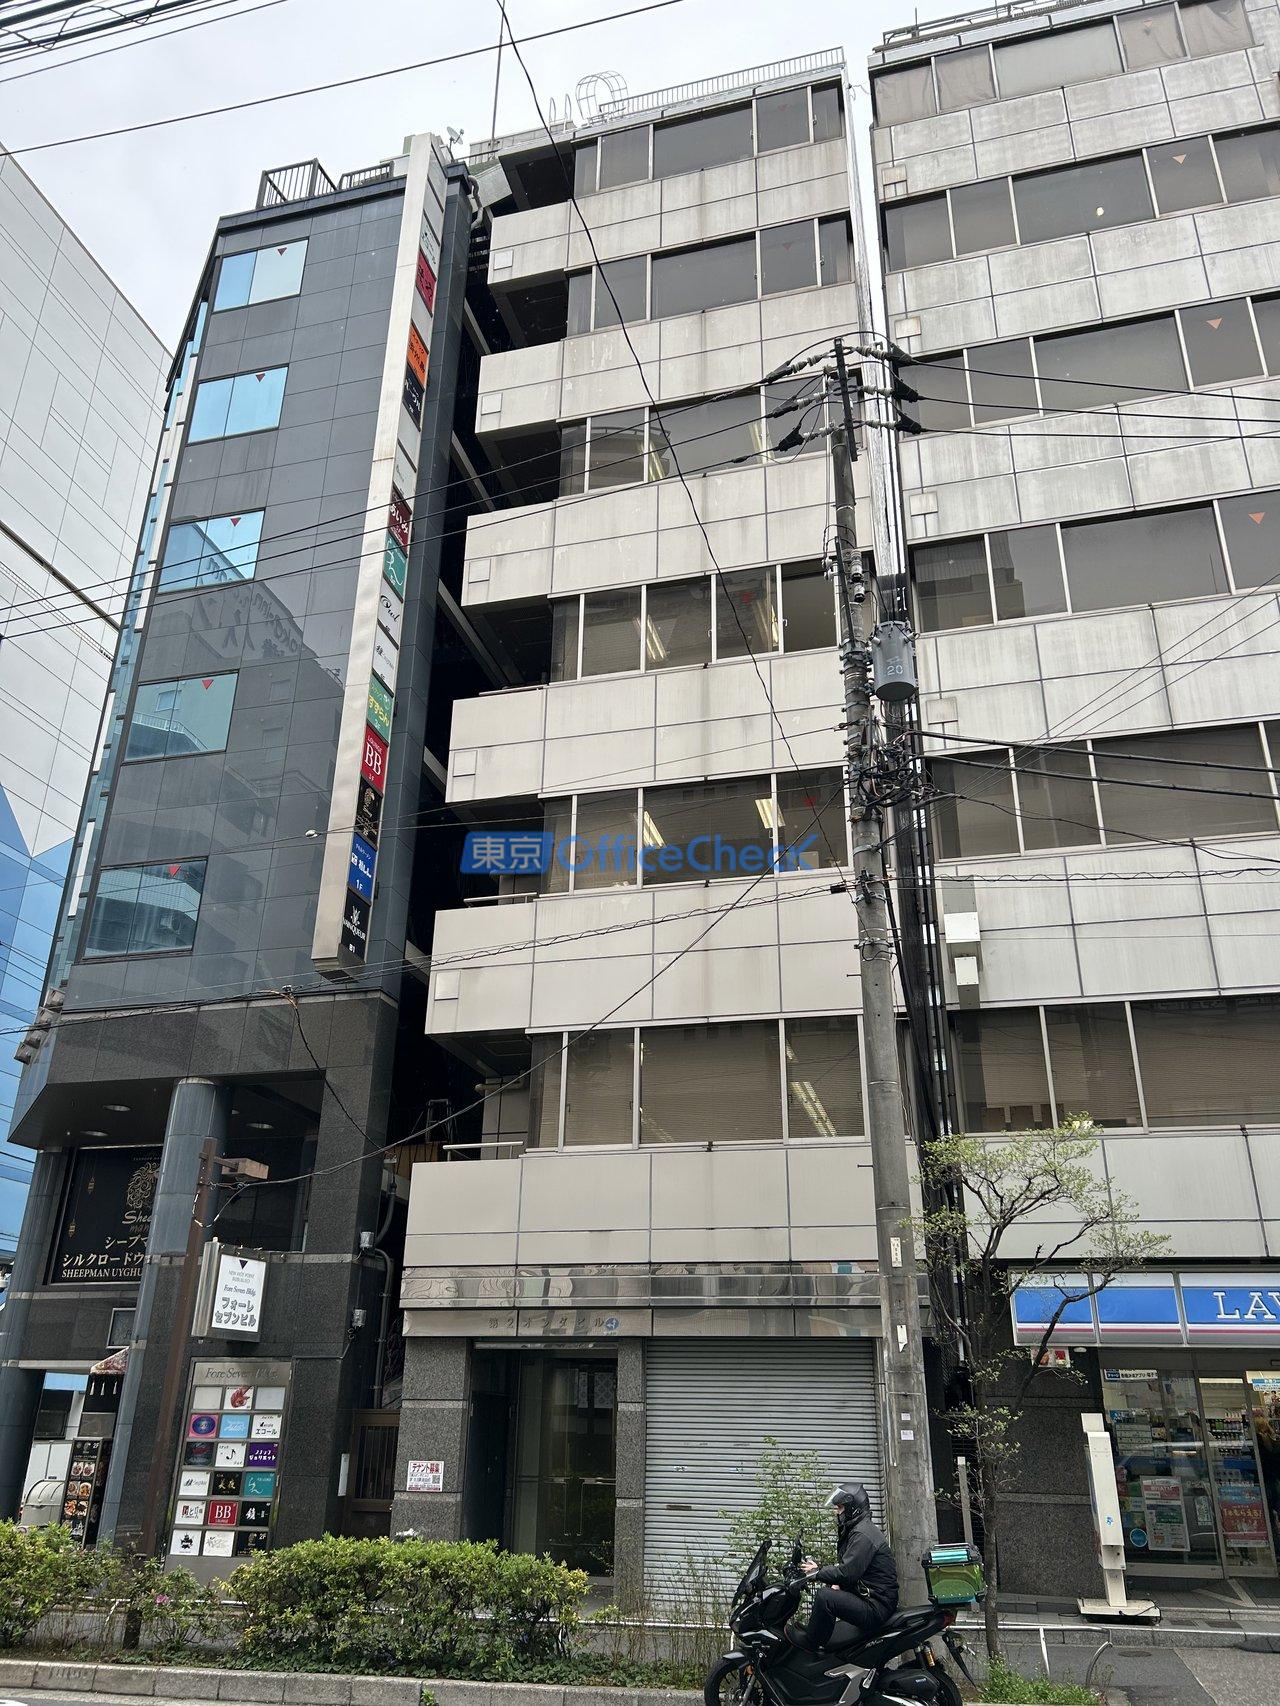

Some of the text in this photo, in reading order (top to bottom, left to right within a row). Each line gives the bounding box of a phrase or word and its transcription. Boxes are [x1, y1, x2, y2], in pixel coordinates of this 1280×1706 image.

[380, 594, 400, 622] Owl
[886, 665, 903, 676] 20
[368, 695, 389, 727] すずらん
[367, 734, 382, 755] LOUNGE
[364, 741, 382, 776] BB
[356, 879, 363, 892] 1F
[61, 1268, 110, 1278] SHEEPMAN
[222, 1296, 254, 1313] フォーレ
[215, 1310, 257, 1327] セブンビル
[204, 1367, 227, 1379] Fore
[412, 1463, 440, 1473] テナント募集
[215, 1505, 232, 1519] BB
